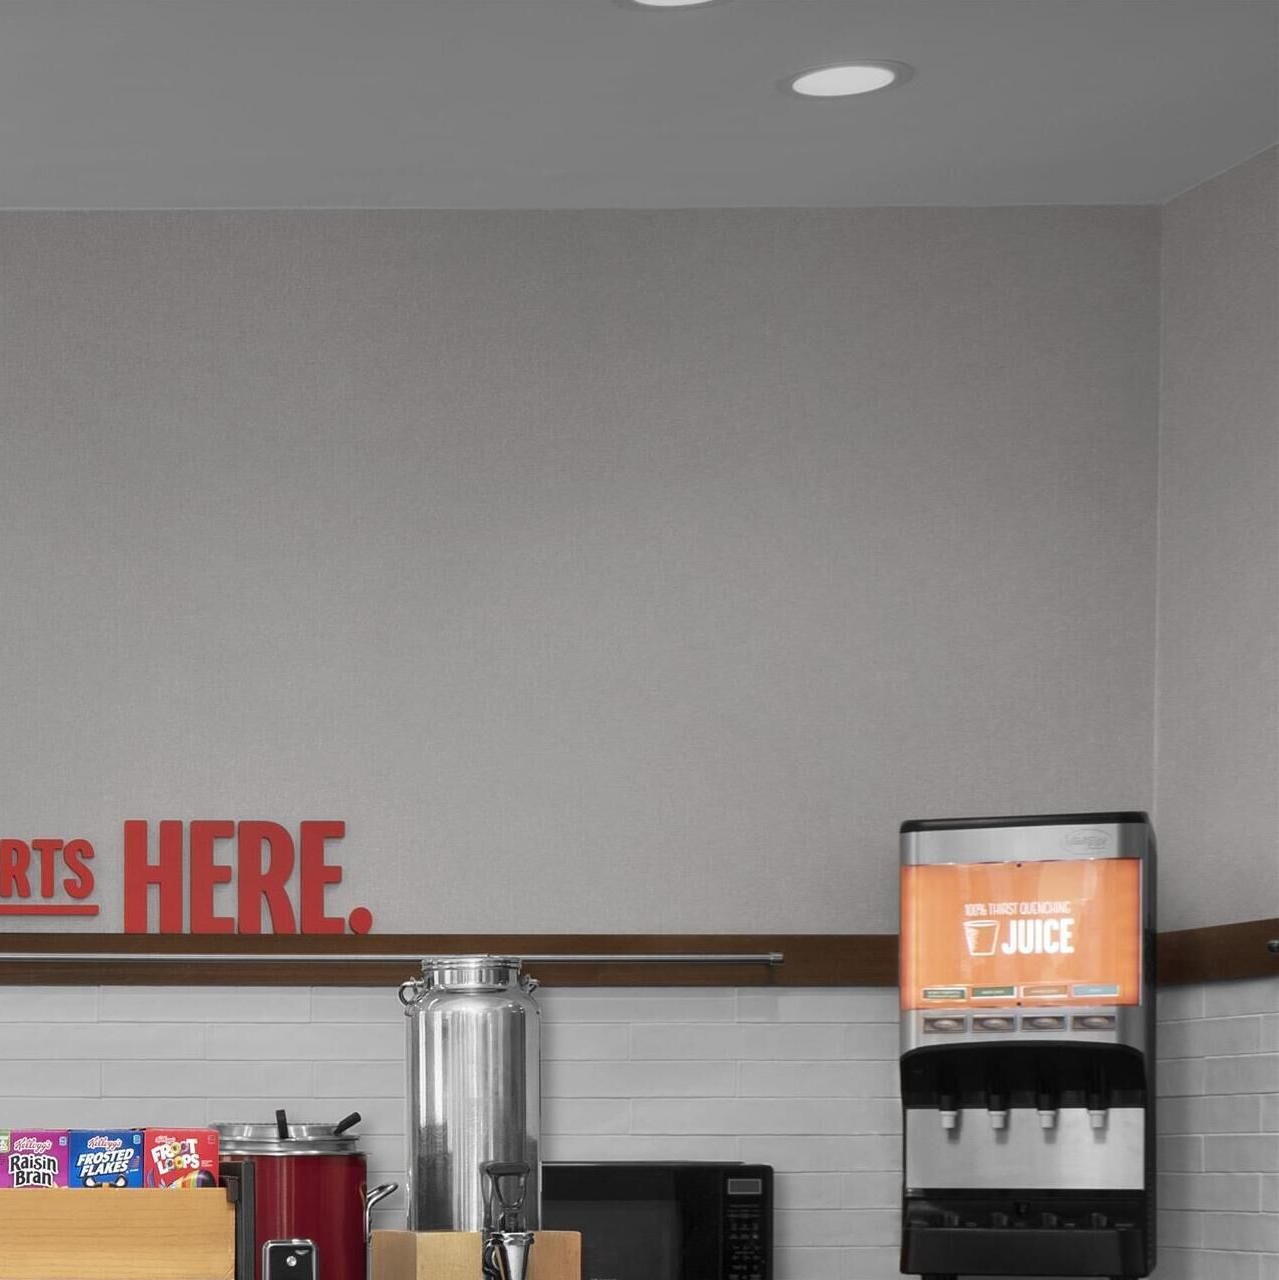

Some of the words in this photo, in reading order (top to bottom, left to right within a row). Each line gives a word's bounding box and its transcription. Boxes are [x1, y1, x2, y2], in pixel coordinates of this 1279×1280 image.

[124, 820, 373, 934] HERE.
[988, 902, 1019, 915] THIRST
[1019, 900, 1071, 915] QUENCHING
[1002, 918, 1075, 955] JUICE
[14, 1137, 52, 1153] Kellogg's
[87, 1136, 123, 1150] Kellogg's
[150, 1138, 198, 1163] FROOT
[10, 1155, 57, 1172] Raisin
[76, 1148, 135, 1167] FROSTED
[157, 1153, 200, 1176] LOOPS
[80, 1160, 129, 1177] FLAKES
[15, 1170, 52, 1186] Bran
